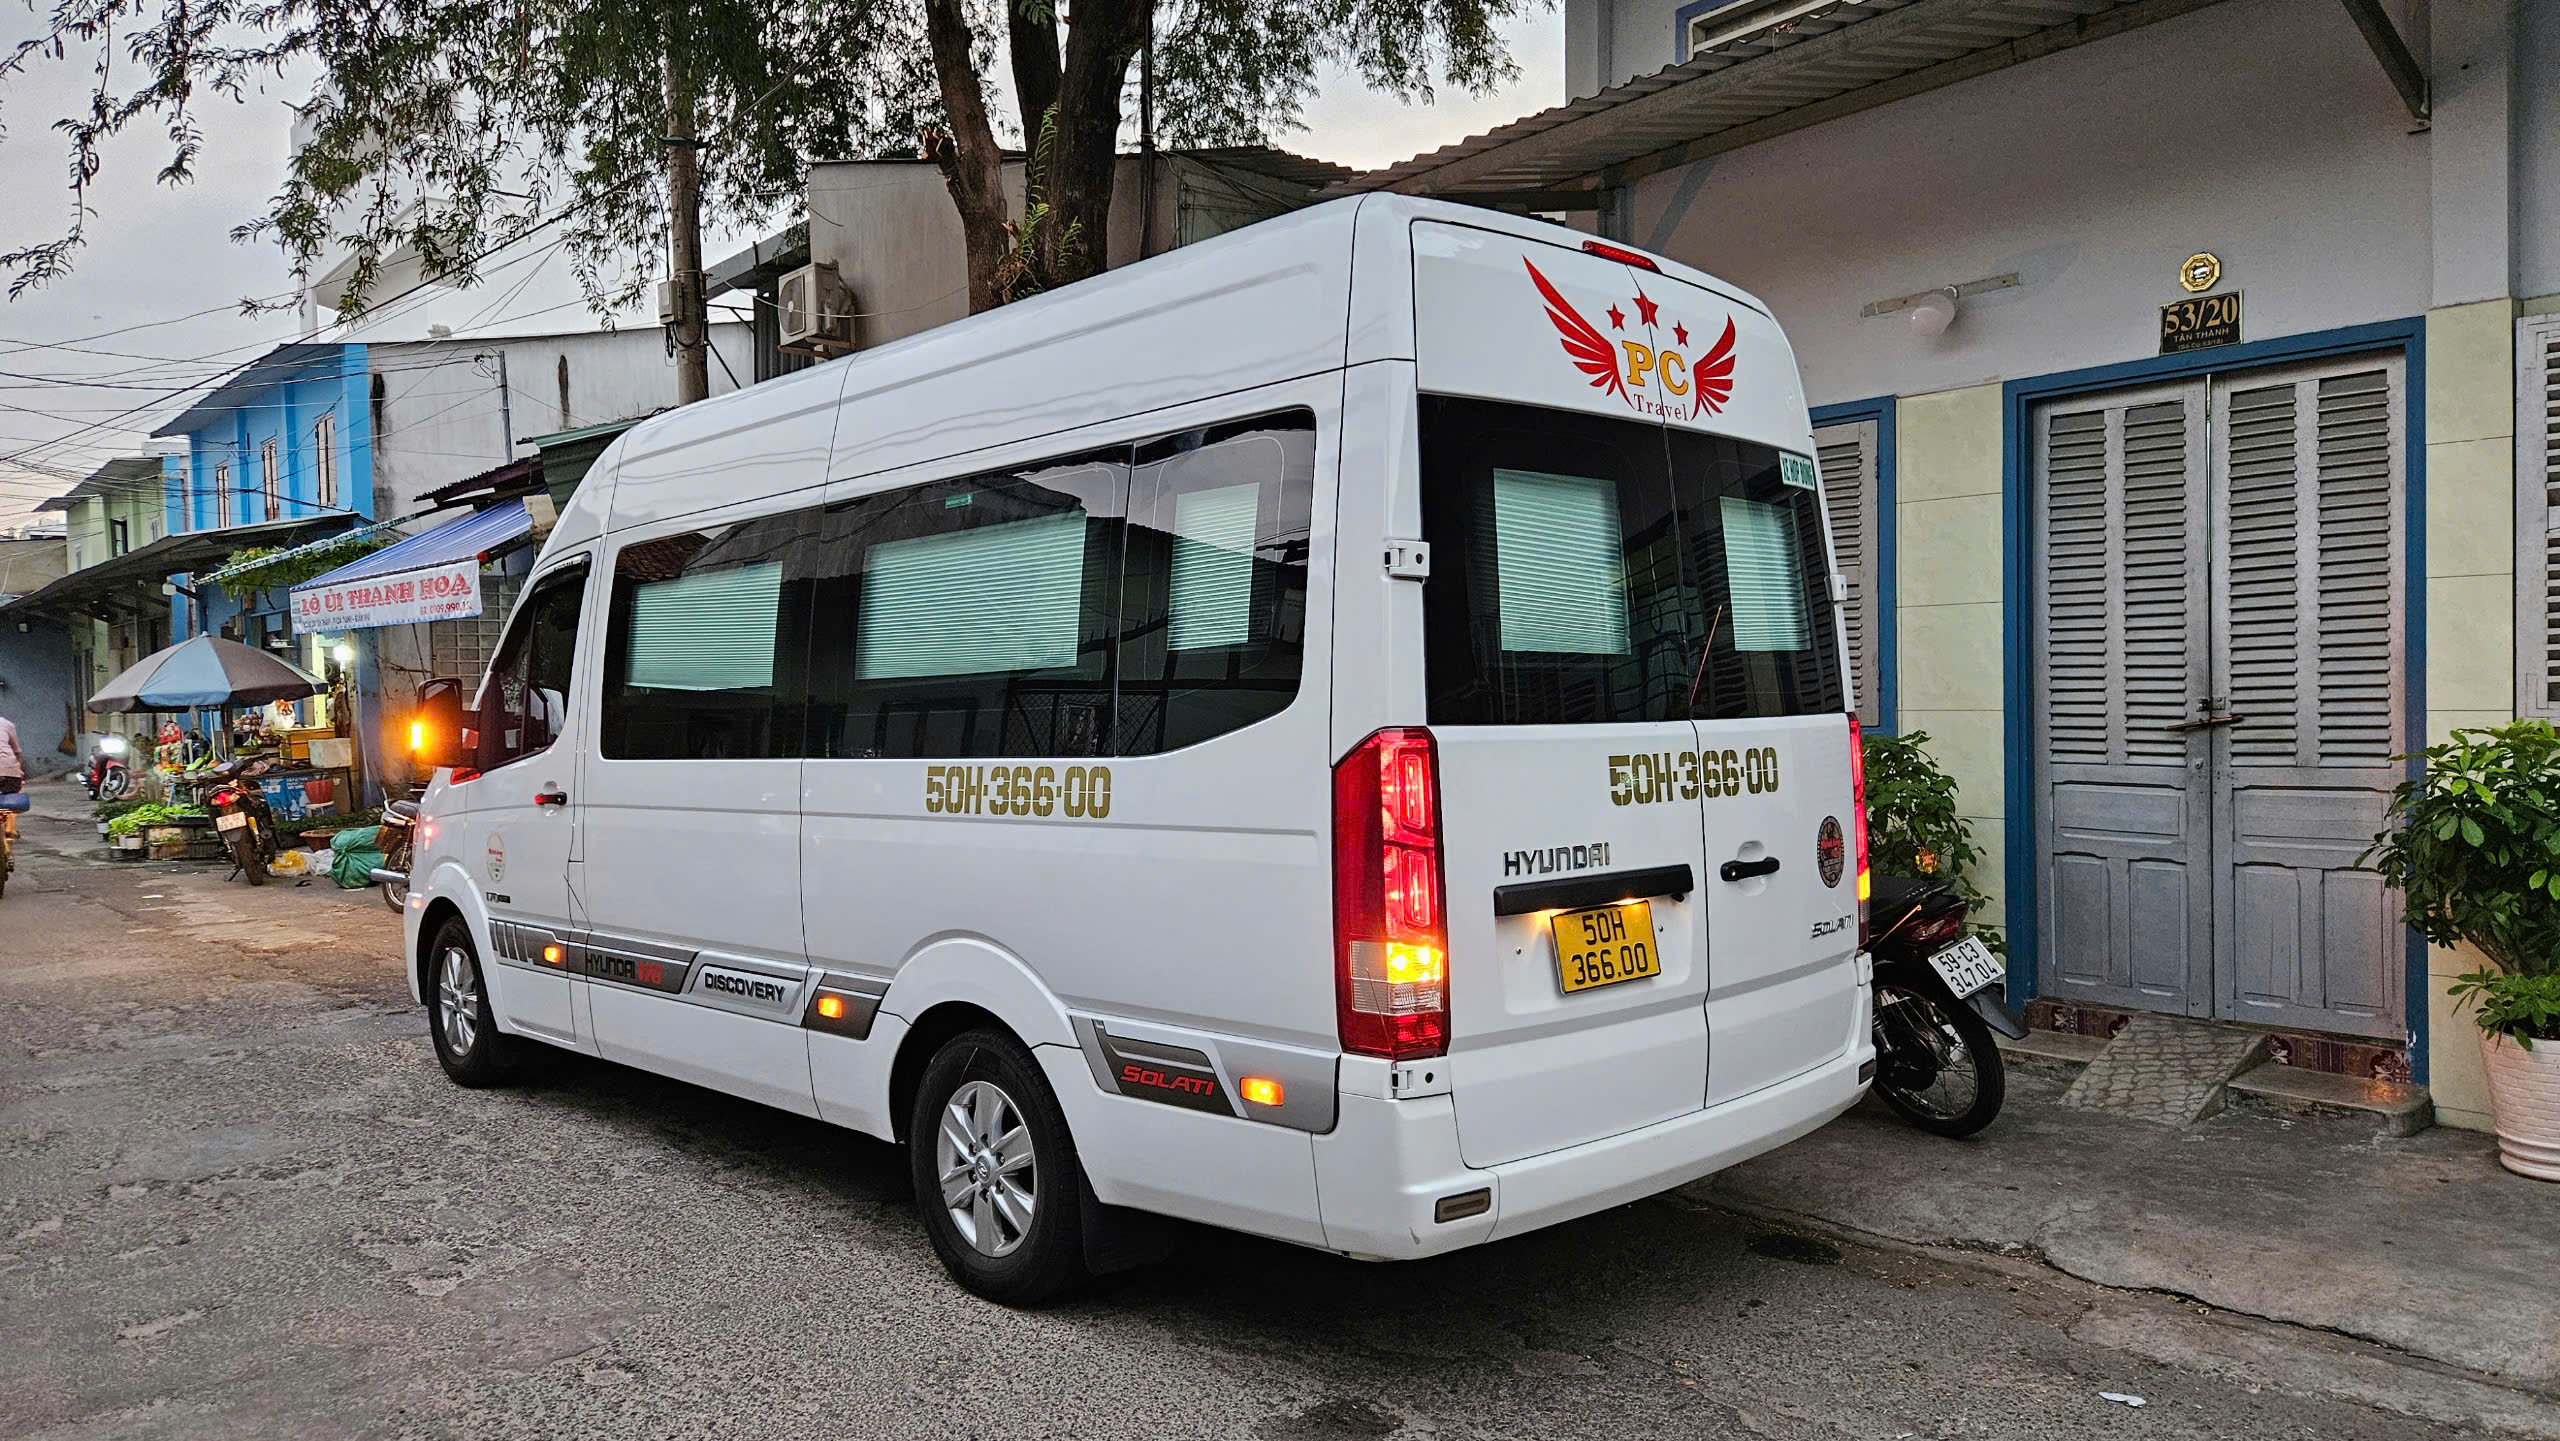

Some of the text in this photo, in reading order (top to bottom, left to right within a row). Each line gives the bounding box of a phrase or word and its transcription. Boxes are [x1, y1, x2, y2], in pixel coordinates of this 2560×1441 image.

[2165, 296, 2238, 334] 53/20
[1622, 340, 1689, 396] PC
[1634, 393, 1688, 421] Travel
[301, 593, 321, 616] LÒ
[346, 580, 415, 609] THANH
[419, 573, 472, 599] HOA
[1504, 842, 1611, 877] HYUNDAI
[1582, 910, 1626, 946] 50H
[1571, 942, 1648, 986] 366.00
[1938, 943, 1980, 973] 59-C3
[1951, 959, 1998, 993] 347.04
[585, 953, 785, 1003] HYUNDAI 170 DISCOVERY
[1121, 1065, 1215, 1096] SOLATI
